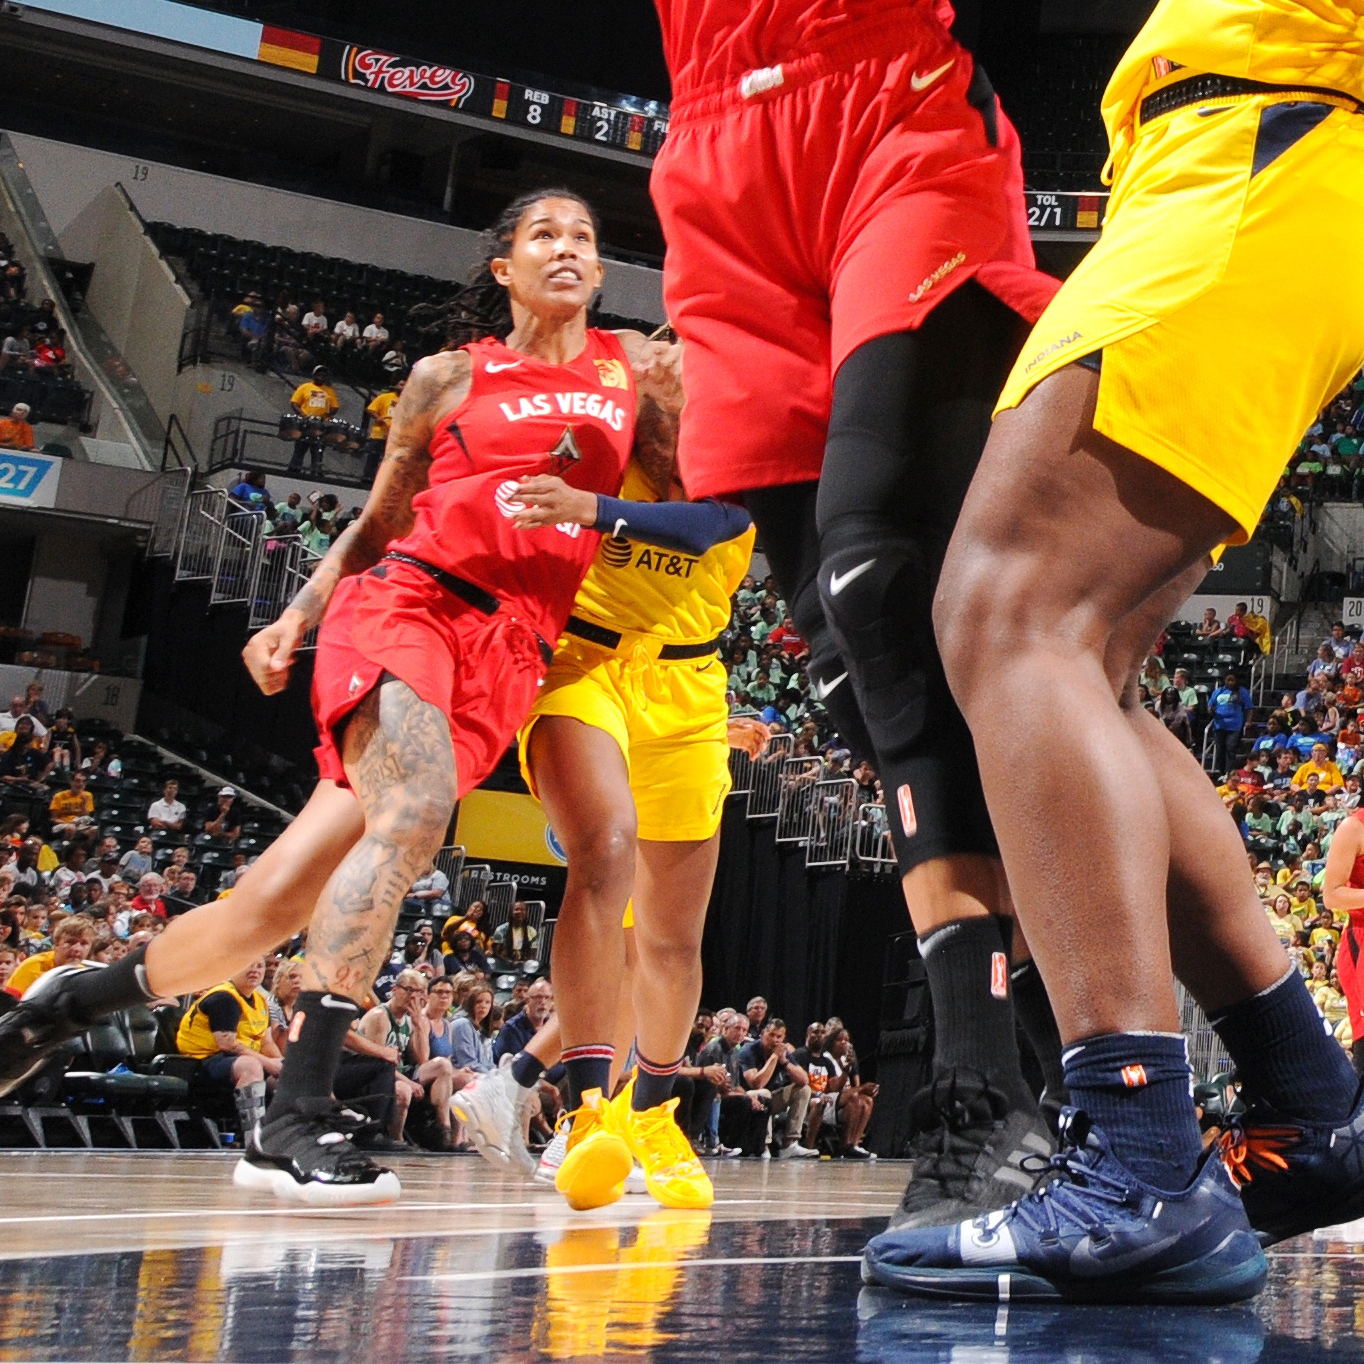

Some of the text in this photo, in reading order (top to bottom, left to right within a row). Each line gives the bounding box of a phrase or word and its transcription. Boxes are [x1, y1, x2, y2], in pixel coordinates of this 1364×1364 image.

[355, 49, 471, 101] Fever
[524, 89, 549, 104] REB
[526, 105, 542, 124] 8
[592, 106, 617, 120] AST
[595, 121, 610, 142] 2
[132, 164, 149, 181] 19
[1036, 194, 1058, 206] TOL
[1028, 207, 1062, 226] 2/1
[1024, 330, 1084, 374] INDIANA
[219, 374, 235, 392] 19
[500, 392, 625, 431] LAS VEGAS
[635, 549, 700, 578] AT&T
[1348, 601, 1362, 617] 20
[470, 870, 547, 886] RESTROOMS
